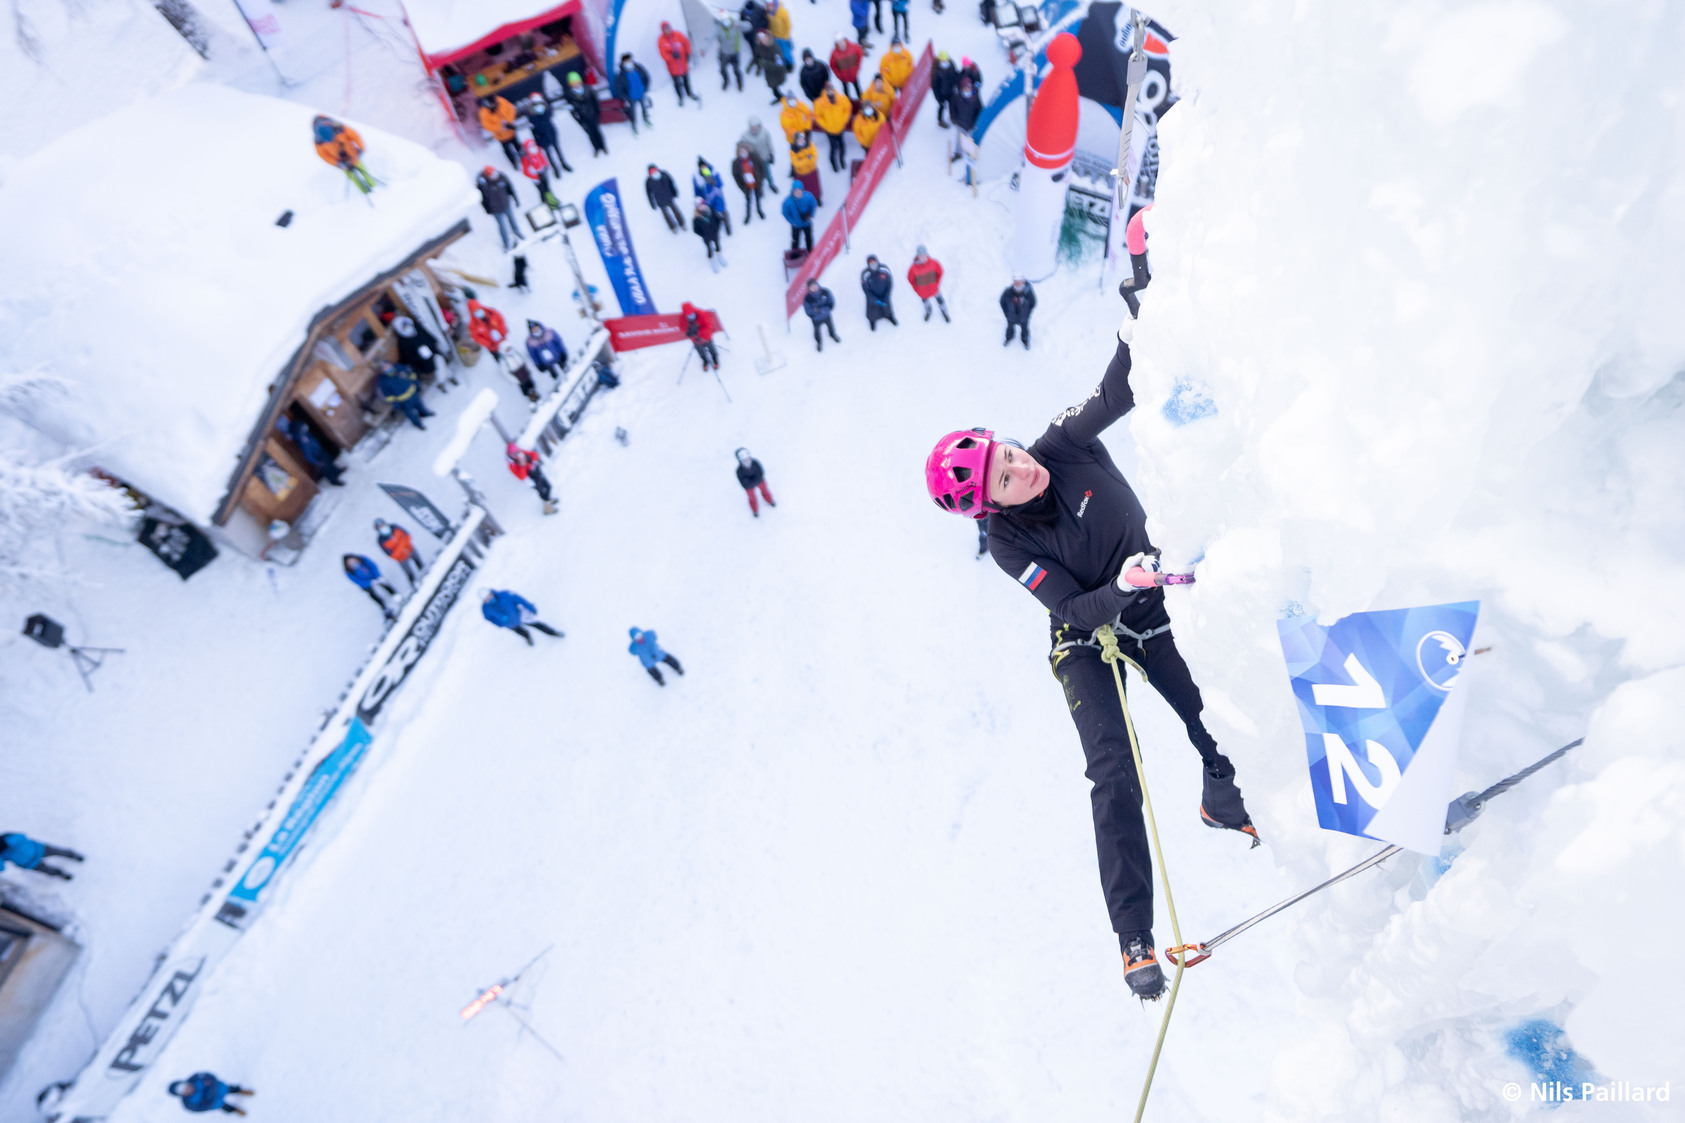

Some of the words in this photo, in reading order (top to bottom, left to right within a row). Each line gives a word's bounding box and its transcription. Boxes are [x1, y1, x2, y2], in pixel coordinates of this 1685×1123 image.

[412, 559, 472, 638] OUTDOOR
[1312, 652, 1402, 811] 12
[108, 955, 206, 1073] PETZL
